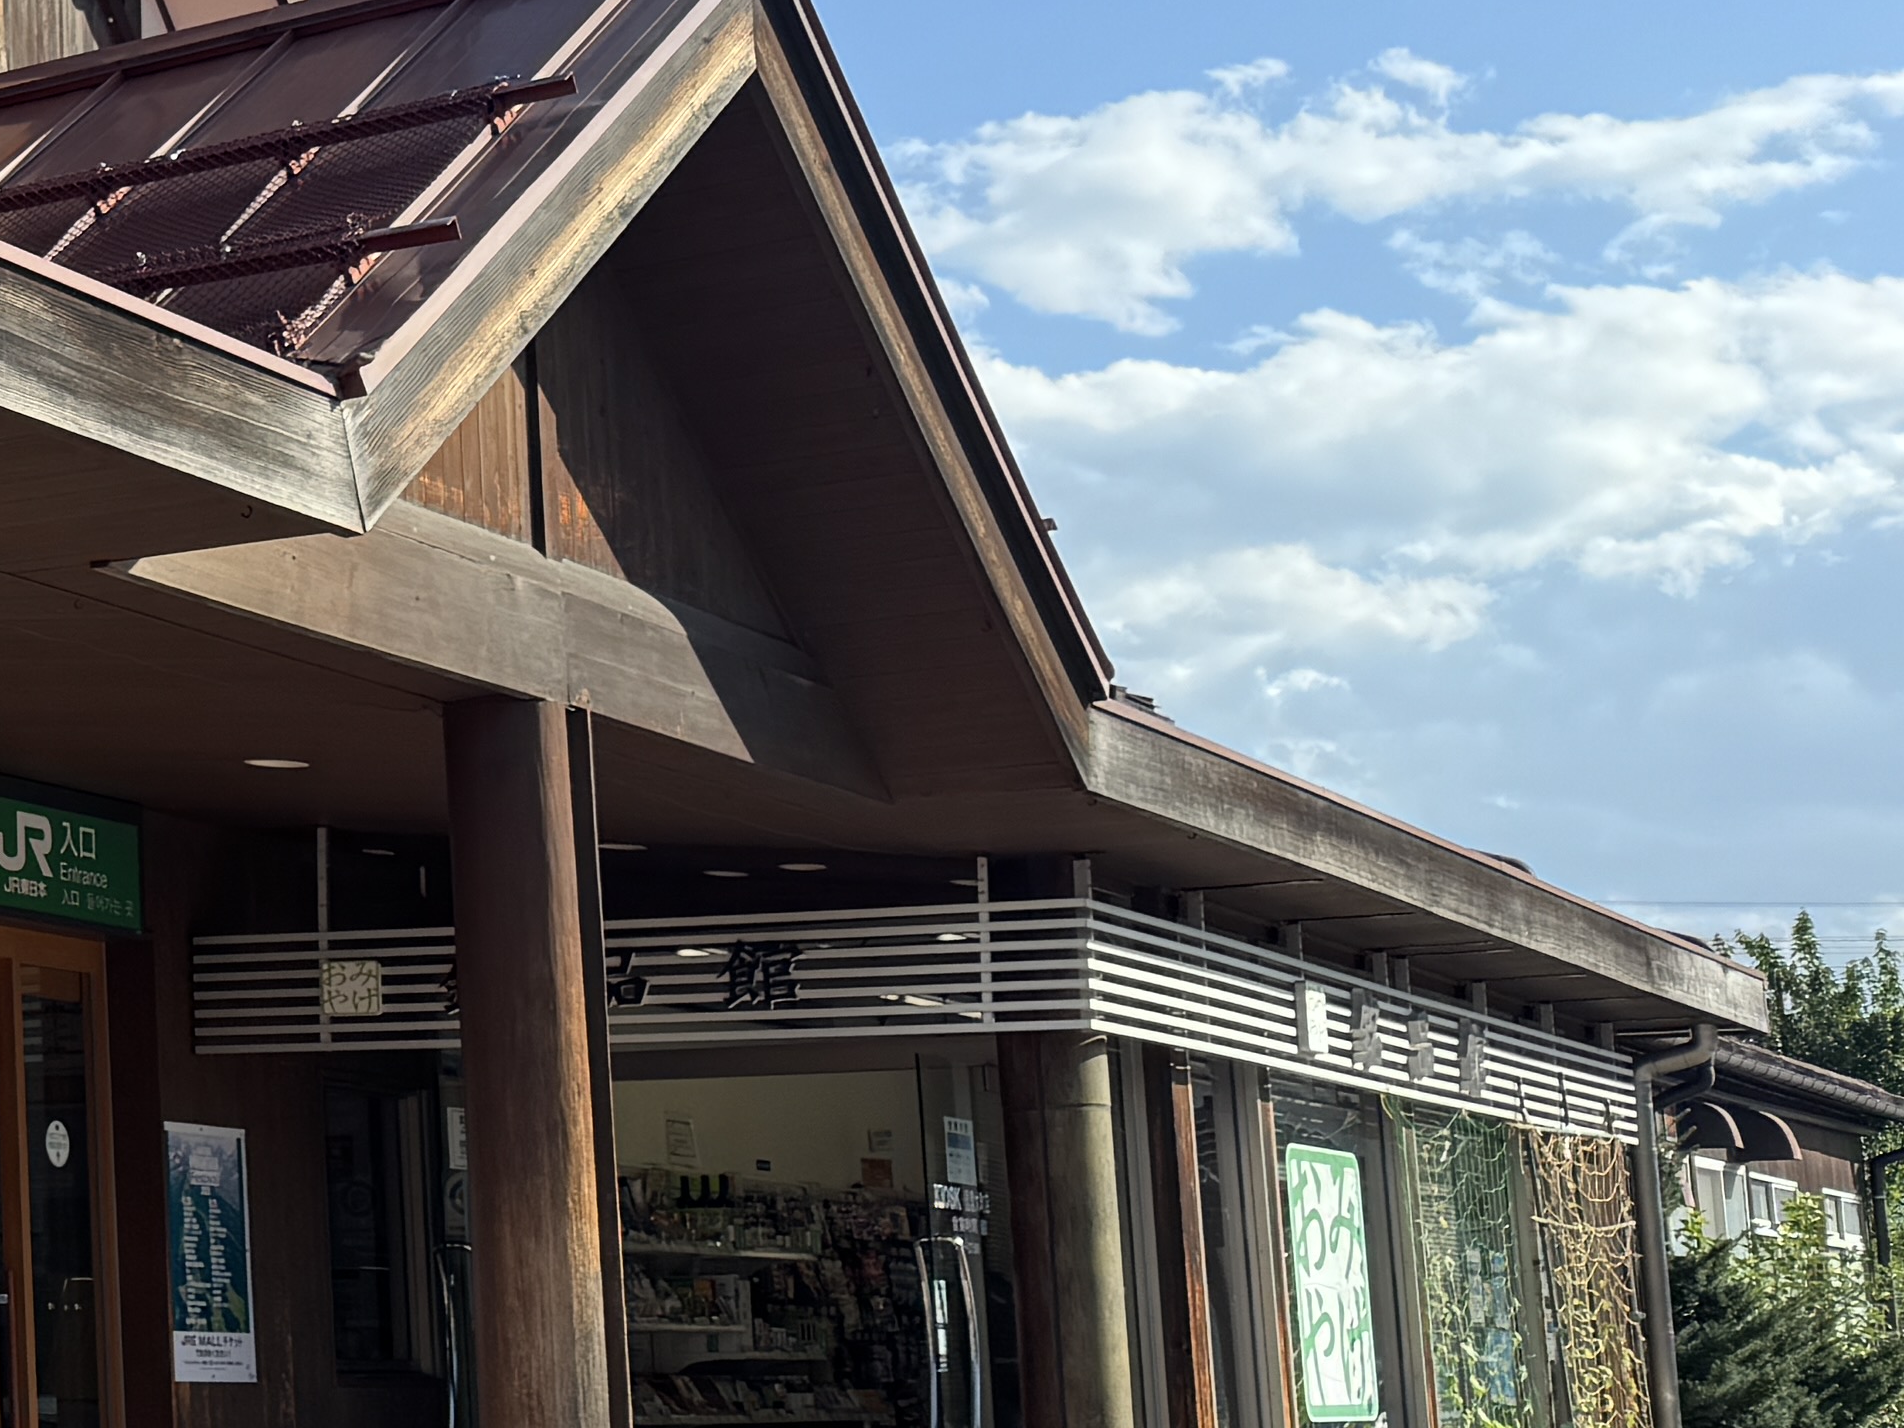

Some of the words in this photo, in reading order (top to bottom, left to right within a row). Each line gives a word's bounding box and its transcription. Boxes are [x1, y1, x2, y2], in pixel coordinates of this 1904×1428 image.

[59, 822, 96, 860] 入口
[3, 876, 48, 898] JR東日本
[59, 862, 108, 889] Entrance
[61, 889, 80, 906] 入口
